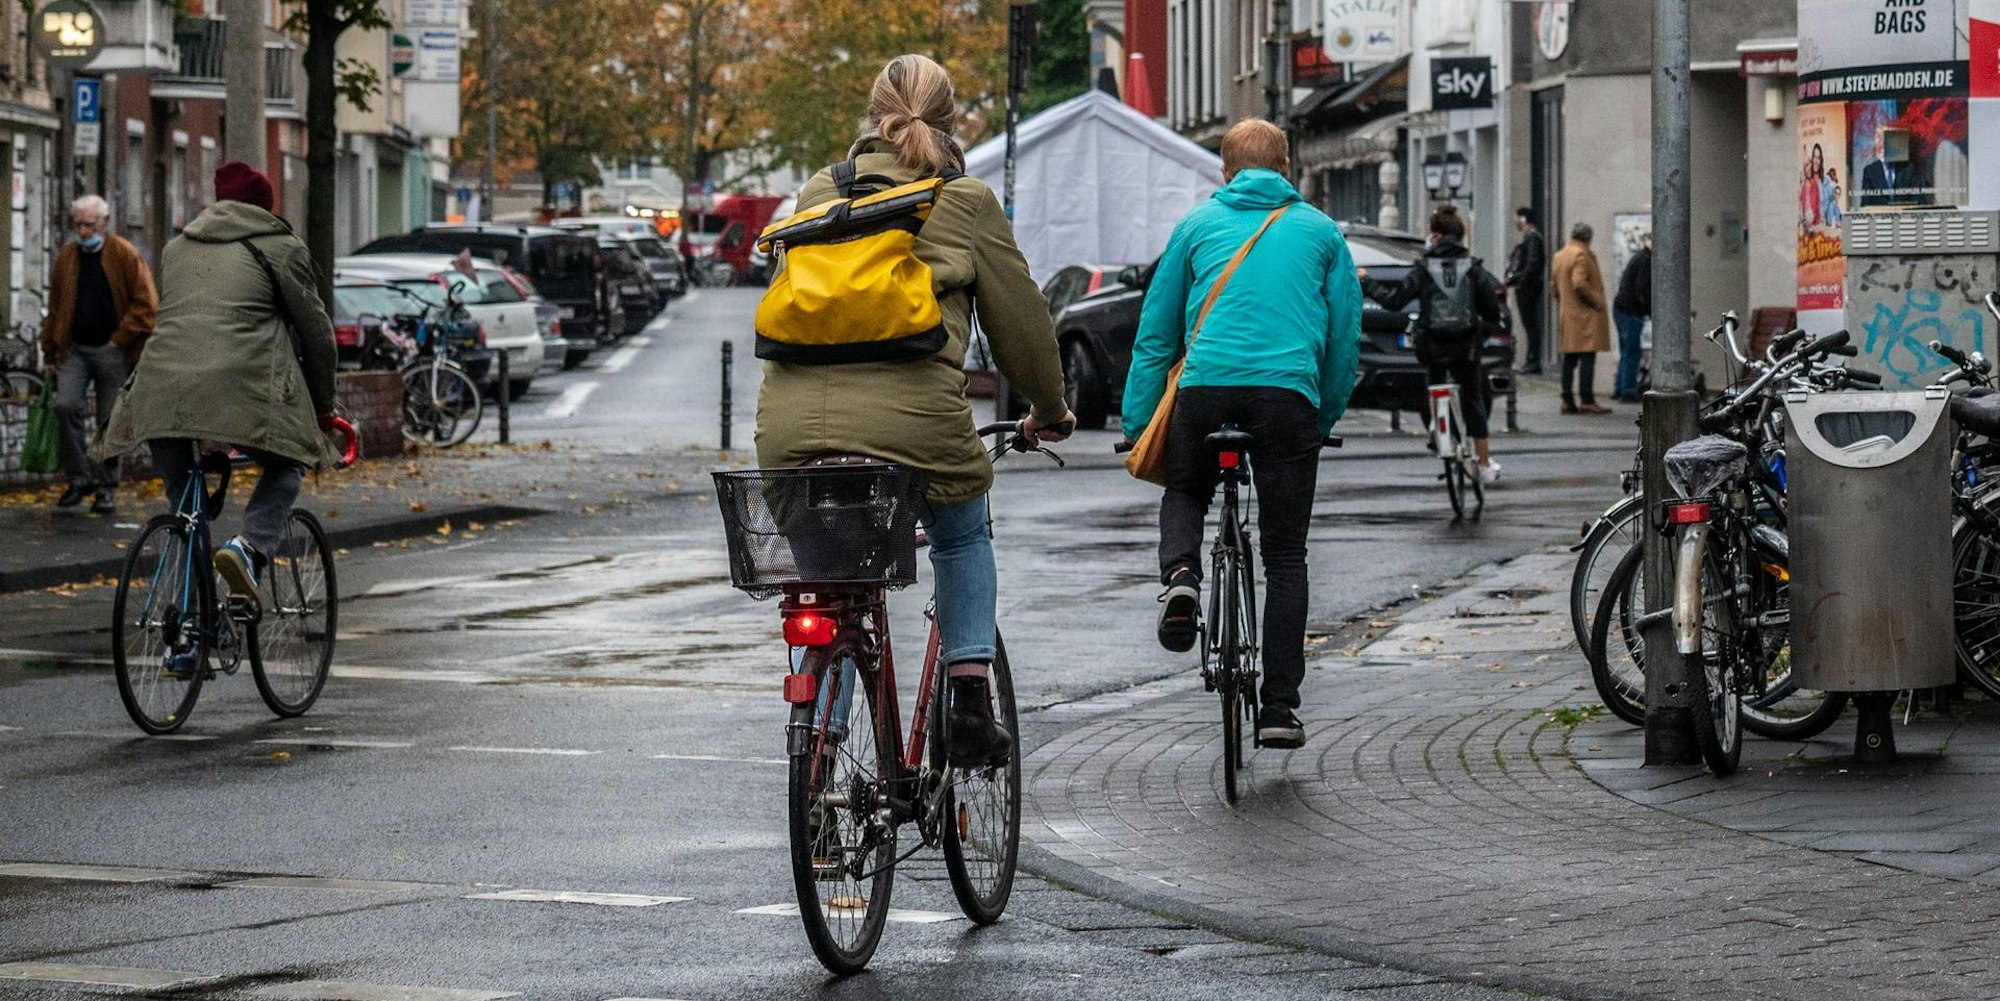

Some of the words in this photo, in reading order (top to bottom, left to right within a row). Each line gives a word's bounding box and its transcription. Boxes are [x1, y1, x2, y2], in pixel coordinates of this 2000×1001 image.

[1874, 10, 1927, 34] BAGS
[1437, 67, 1486, 99] sky
[1822, 69, 1954, 96] WWW.STEVEMADDEN.DE
[77, 85, 92, 120] P
